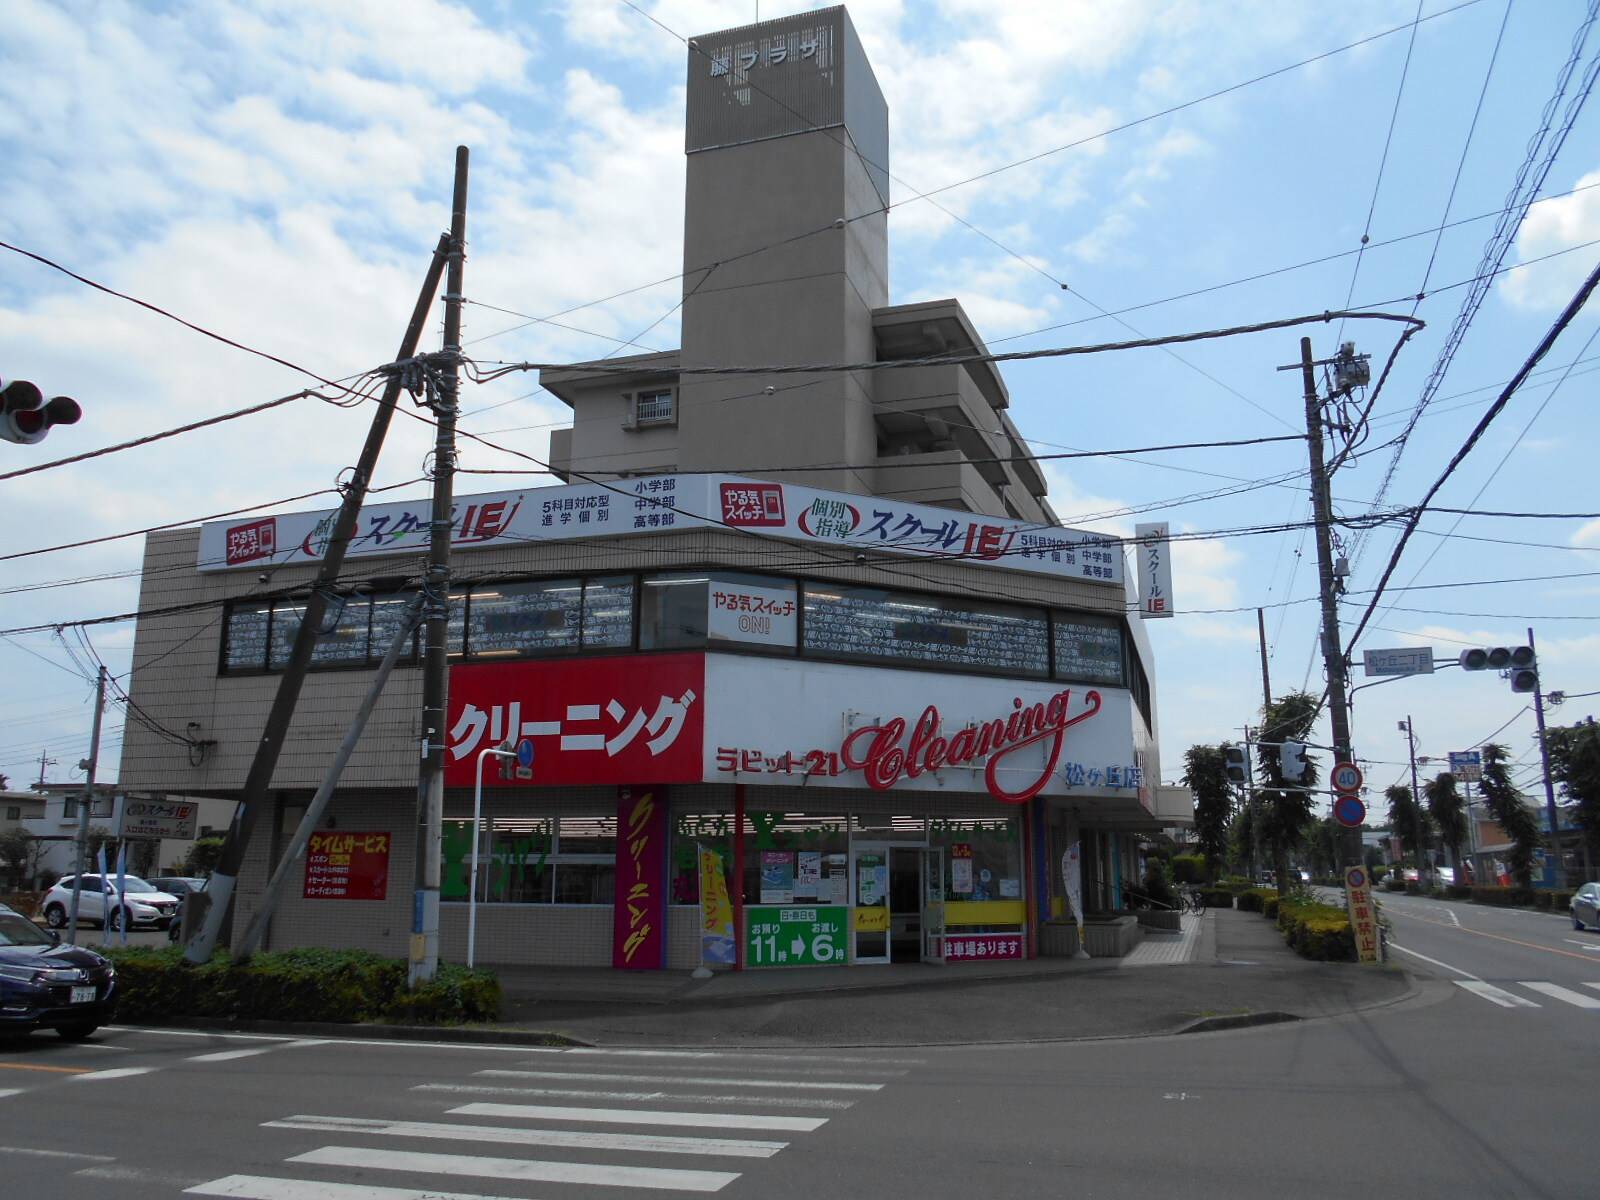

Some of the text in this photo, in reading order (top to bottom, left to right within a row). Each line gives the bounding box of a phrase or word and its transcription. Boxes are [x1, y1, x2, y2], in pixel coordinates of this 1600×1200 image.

[635, 478, 676, 494] 小学部
[542, 494, 610, 513] 5科目対応型
[634, 495, 676, 511] 中学部
[725, 490, 760, 505] やる気
[725, 505, 764, 520] スイッチ
[811, 497, 848, 520] 個別
[633, 512, 675, 529] 高等部
[815, 519, 852, 539] 指導
[229, 528, 260, 545] やる気
[228, 541, 259, 559] スイッチ
[1081, 549, 1113, 564] 中学部
[1082, 564, 1114, 579] 高等部
[712, 591, 795, 616] やる気スイッチ
[738, 614, 770, 635] ON!
[449, 688, 697, 761] クリーニング
[841, 687, 1102, 804] Cleaning
[1339, 771, 1355, 785] 40
[310, 834, 388, 854] タイムサービス
[623, 792, 656, 965] クリーニング
[811, 922, 839, 934] お渡し
[1351, 890, 1376, 951] 駐車禁止
